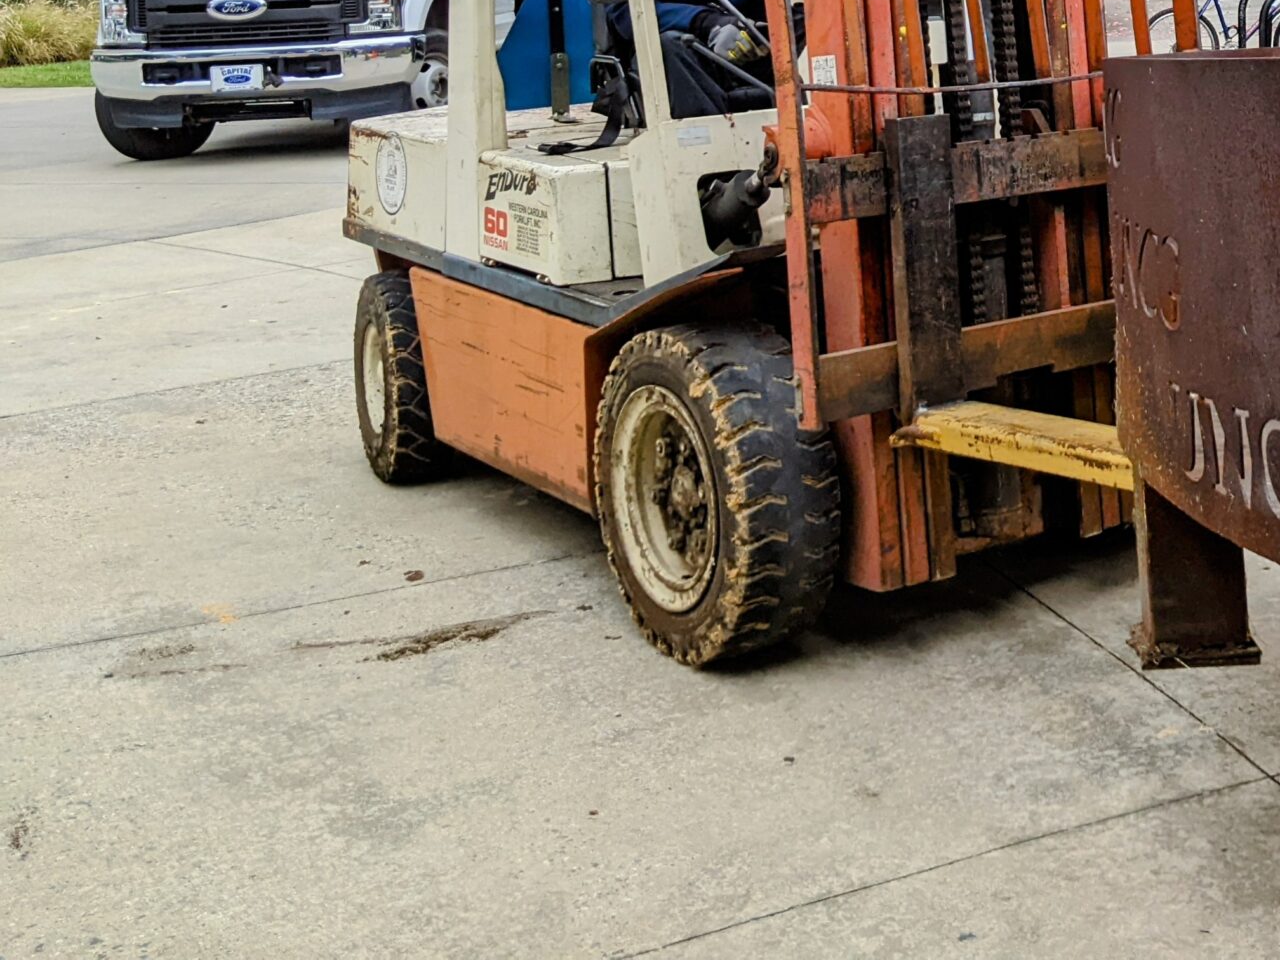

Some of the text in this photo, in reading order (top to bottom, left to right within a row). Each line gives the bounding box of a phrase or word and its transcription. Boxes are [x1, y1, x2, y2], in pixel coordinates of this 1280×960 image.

[221, 1, 250, 13] Ford
[221, 67, 252, 76] CAPITAL
[483, 206, 508, 238] 60
[483, 234, 508, 251] NISSAN
